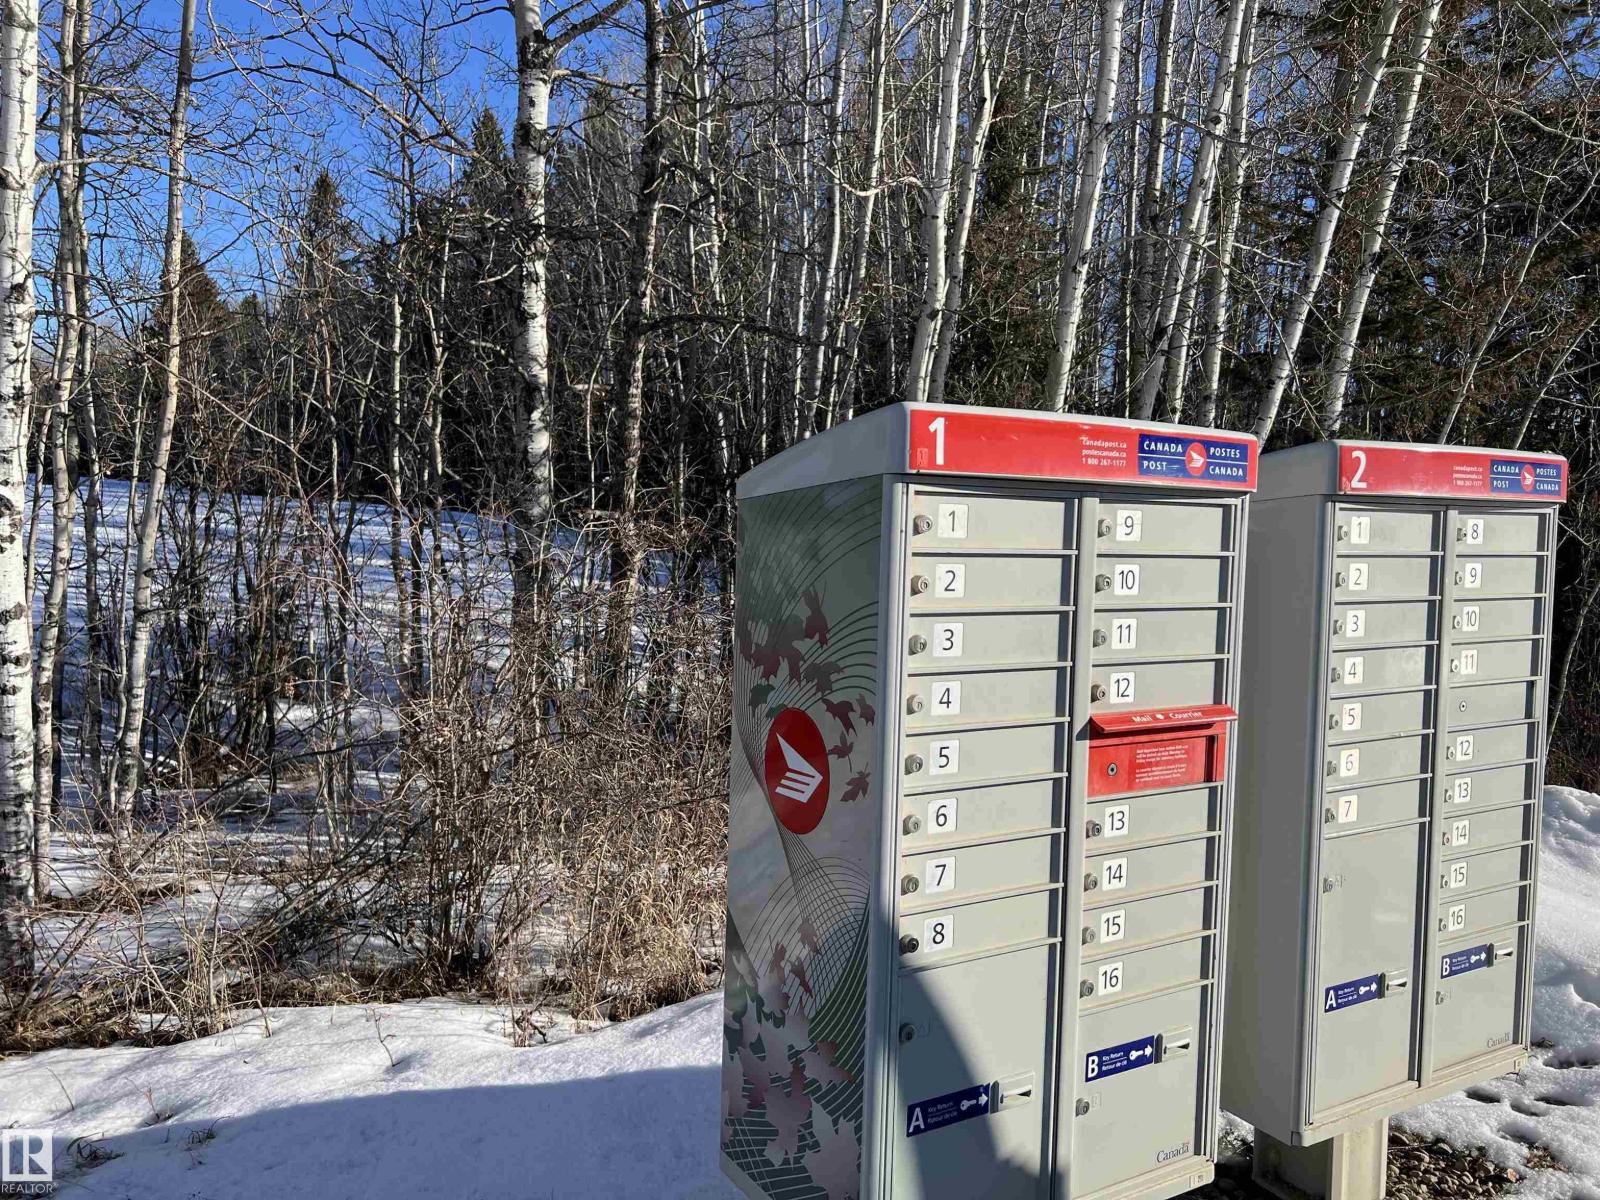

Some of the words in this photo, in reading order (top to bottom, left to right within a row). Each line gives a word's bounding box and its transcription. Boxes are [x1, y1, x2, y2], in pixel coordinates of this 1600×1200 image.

[928, 416, 946, 466] 1
[1143, 441, 1183, 453] CANADA
[1209, 447, 1240, 458] POSTES
[1143, 461, 1168, 470] POST
[1209, 466, 1243, 476] CANADA
[1351, 451, 1367, 488] 2
[1493, 465, 1519, 473] CANADA
[1493, 480, 1509, 488] POST
[1536, 482, 1558, 490] CANADA
[948, 510, 956, 532] 1
[1125, 516, 1134, 535] 9
[1356, 521, 1362, 539] 1
[1471, 524, 1478, 540] 8
[944, 570, 955, 591] 2
[1118, 570, 1135, 589] 10
[1353, 568, 1361, 585] 2
[1469, 568, 1477, 583] 9
[1351, 615, 1358, 632] 3
[1465, 611, 1476, 626] 10
[943, 629, 953, 650] 3
[1116, 624, 1130, 643] 11
[1348, 662, 1356, 678] 4
[1464, 654, 1474, 670] 11
[1114, 678, 1130, 697] 12
[939, 688, 951, 708] 4
[1132, 714, 1152, 723] Mail
[1347, 708, 1355, 725] 5
[1459, 740, 1470, 756] 12
[939, 747, 949, 768] 5
[1345, 754, 1353, 772] 6
[1457, 782, 1468, 798] 13
[936, 805, 947, 827] 6
[1344, 801, 1351, 817] 7
[1108, 811, 1124, 830] 13
[1455, 825, 1466, 841] 14
[935, 864, 946, 886] 7
[1106, 864, 1123, 884] 14
[1453, 867, 1464, 883] 15
[1104, 916, 1120, 936] 15
[1451, 909, 1462, 926] 16
[933, 923, 944, 944] 8
[1443, 958, 1450, 975] B
[1101, 968, 1118, 989] 16
[1325, 990, 1336, 1010] A
[1088, 1055, 1099, 1079] B
[909, 1107, 925, 1132] A
[1156, 1143, 1190, 1162] Canada
